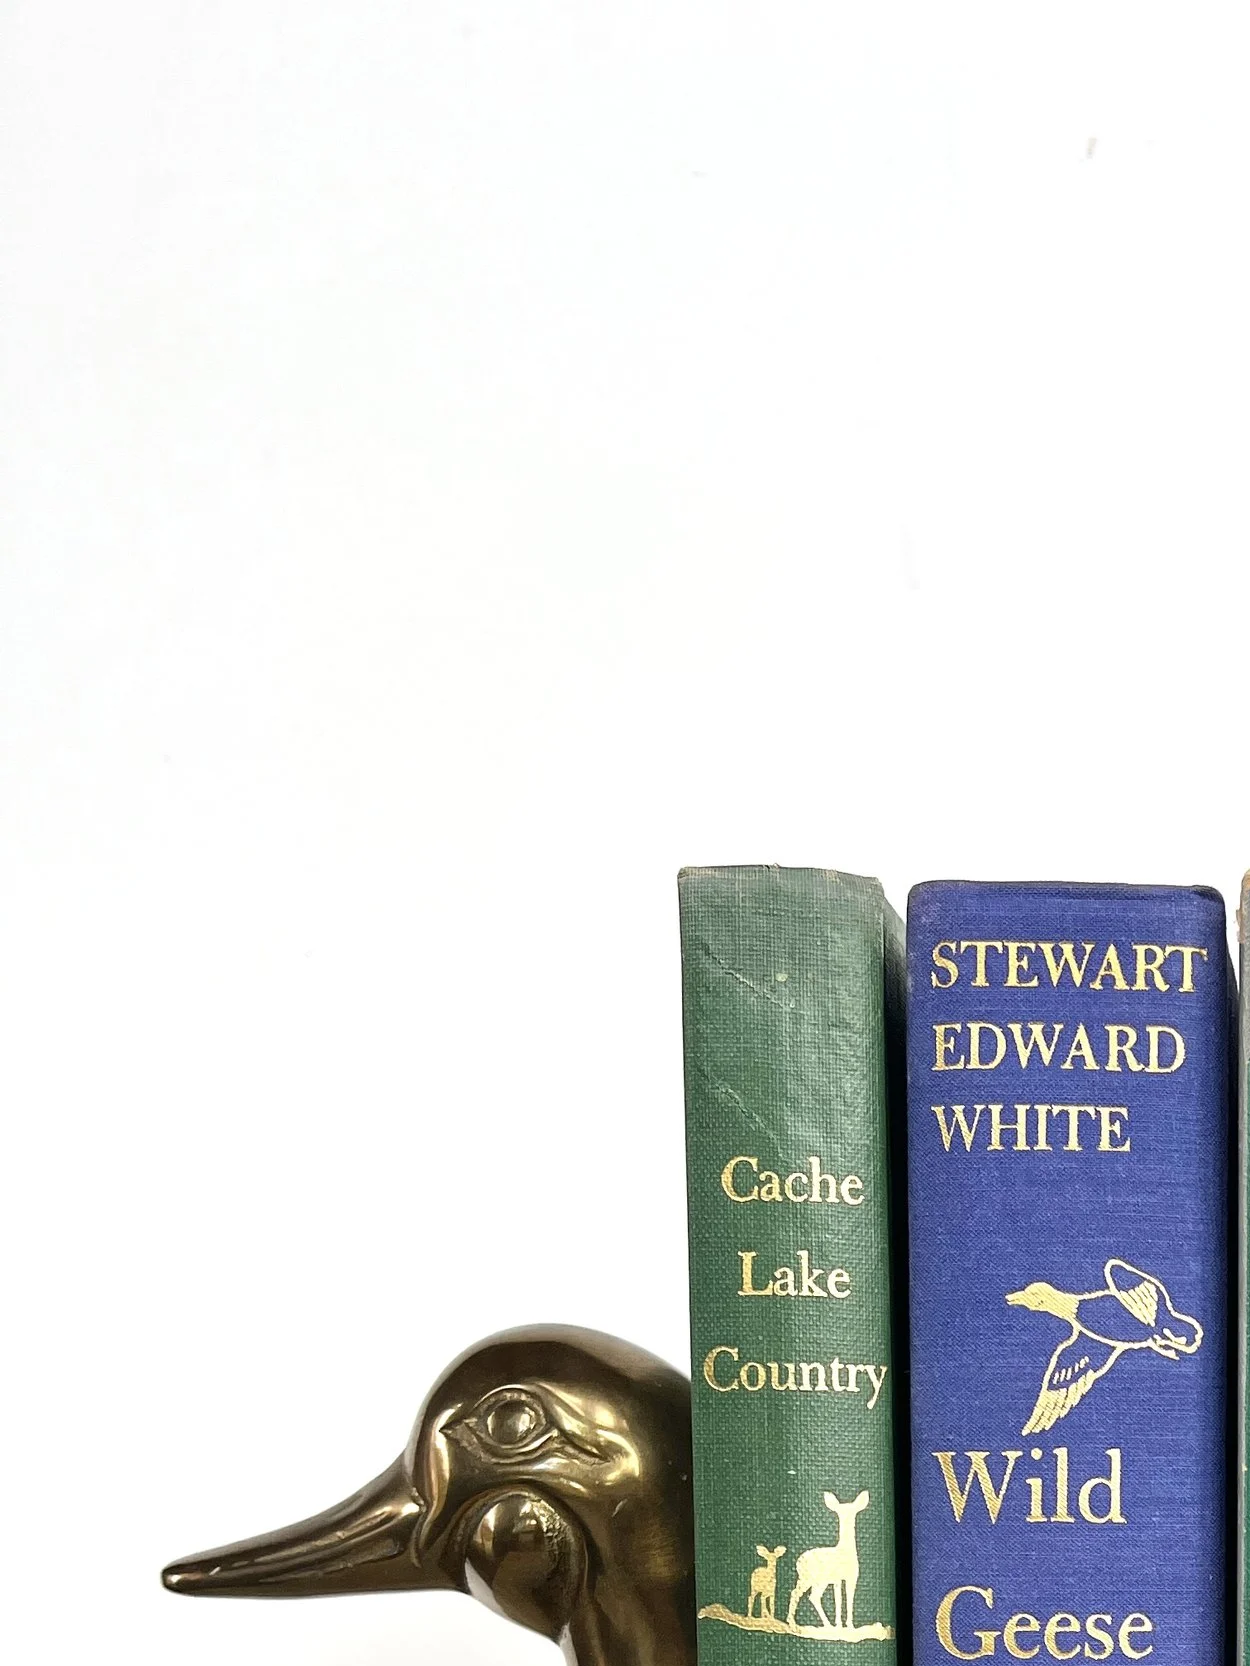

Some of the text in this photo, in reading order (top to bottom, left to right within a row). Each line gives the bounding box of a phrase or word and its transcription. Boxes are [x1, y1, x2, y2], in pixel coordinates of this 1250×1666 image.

[931, 940, 1208, 993] STEWART
[931, 1022, 1187, 1074] EDWARD
[931, 1104, 1131, 1153] WHITE
[720, 1154, 866, 1206] Cache
[736, 1250, 853, 1299] Lake
[702, 1345, 888, 1409] Country
[932, 1447, 1128, 1525] Wild
[935, 1584, 1154, 1661] Geese
